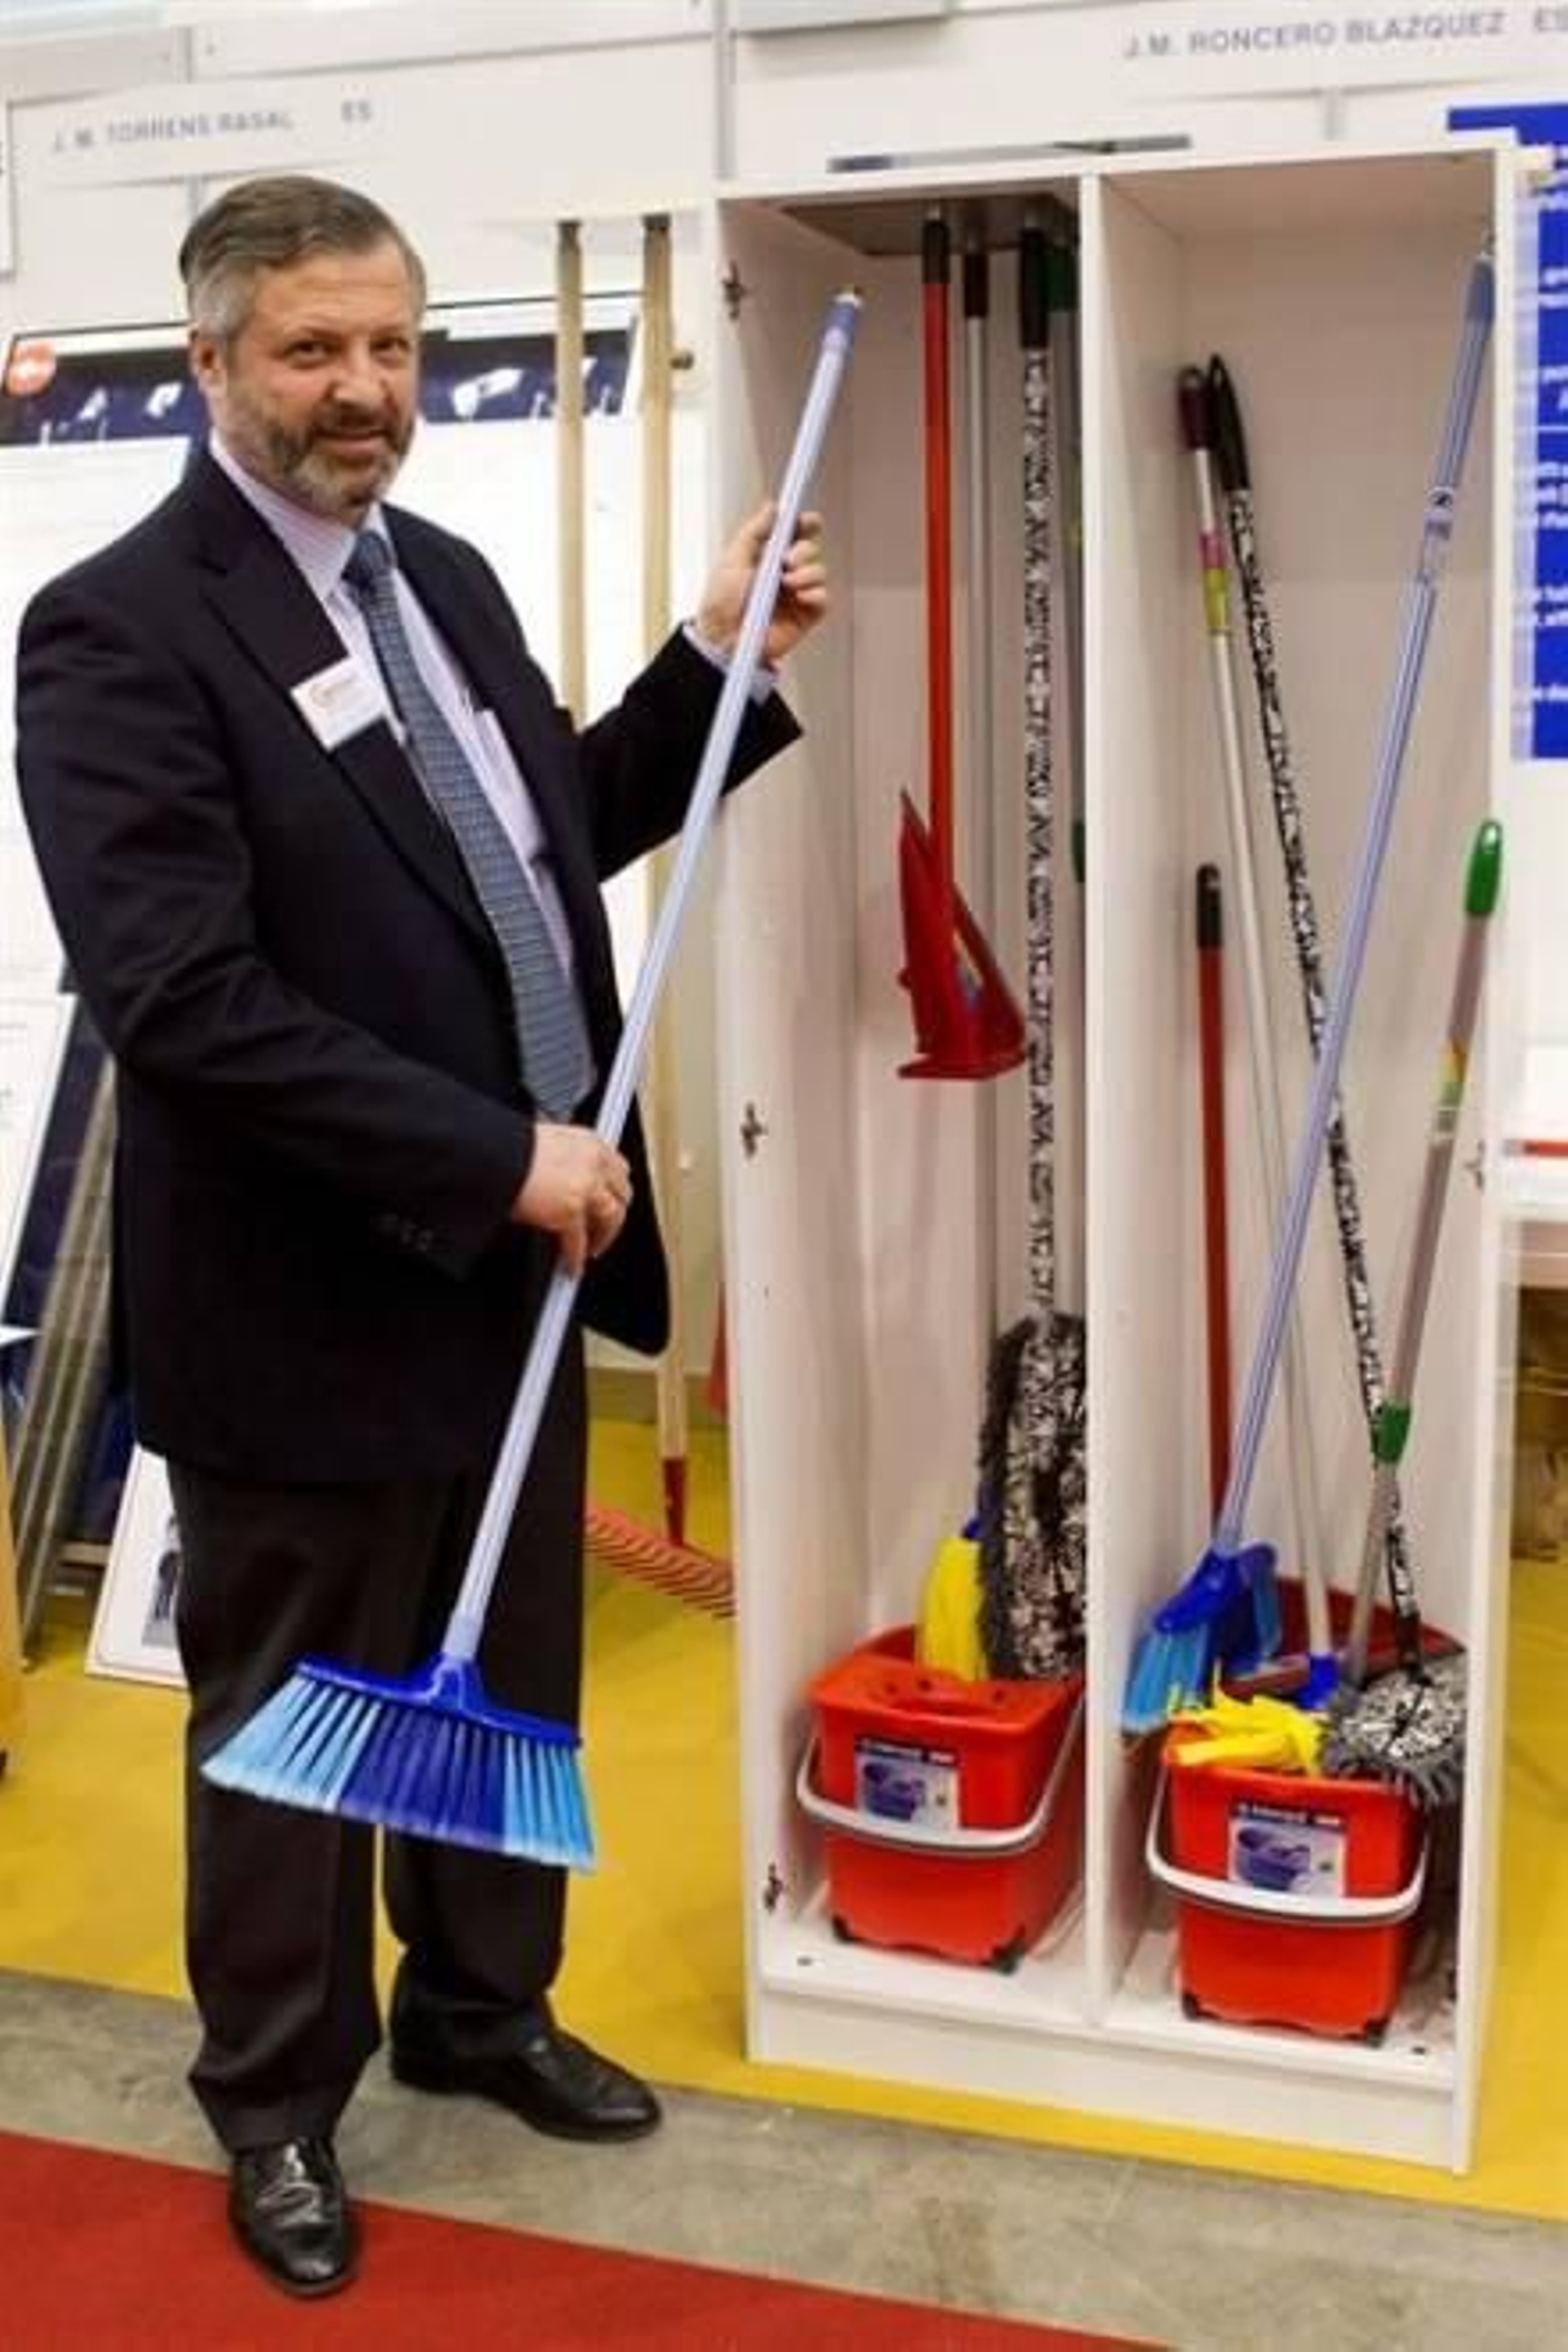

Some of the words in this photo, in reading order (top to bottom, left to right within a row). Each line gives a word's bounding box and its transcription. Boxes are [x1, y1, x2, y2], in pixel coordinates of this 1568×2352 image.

[1189, 22, 1337, 53] RONCERO
[1346, 10, 1506, 44] BLAZQUEZ
[107, 112, 213, 143] TORRENS
[340, 99, 372, 122] ES
